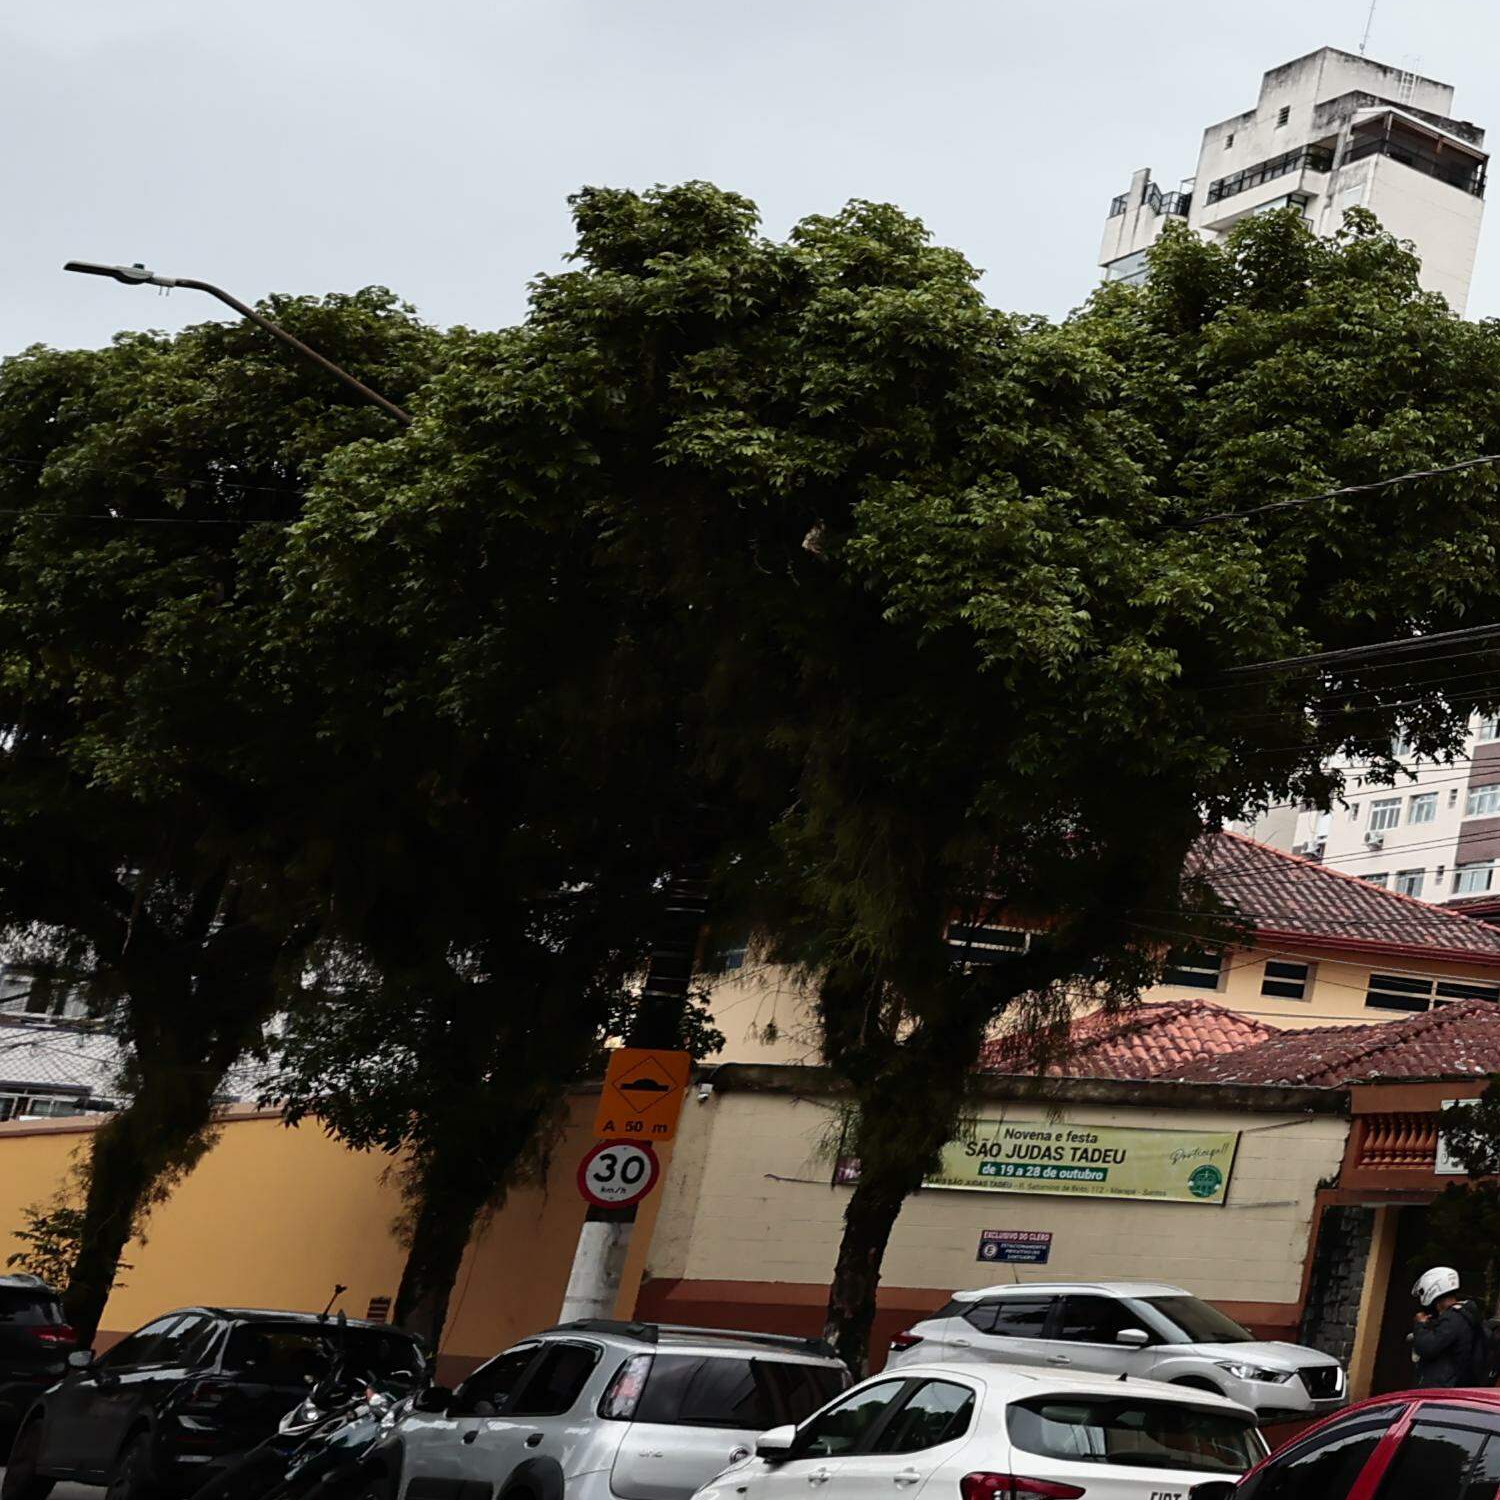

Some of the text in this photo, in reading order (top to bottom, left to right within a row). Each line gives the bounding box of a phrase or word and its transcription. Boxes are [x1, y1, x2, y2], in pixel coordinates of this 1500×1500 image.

[602, 1120, 668, 1133] A 50 m
[1004, 1128, 1098, 1144] Novena e festa
[965, 1138, 1127, 1165] SÃO JUDAS TADEU
[593, 1153, 645, 1185] 30
[982, 1164, 1104, 1180] de 19 a 28 de outubro
[600, 1185, 627, 1195] km/h
[1029, 1233, 1050, 1241] CLERO
